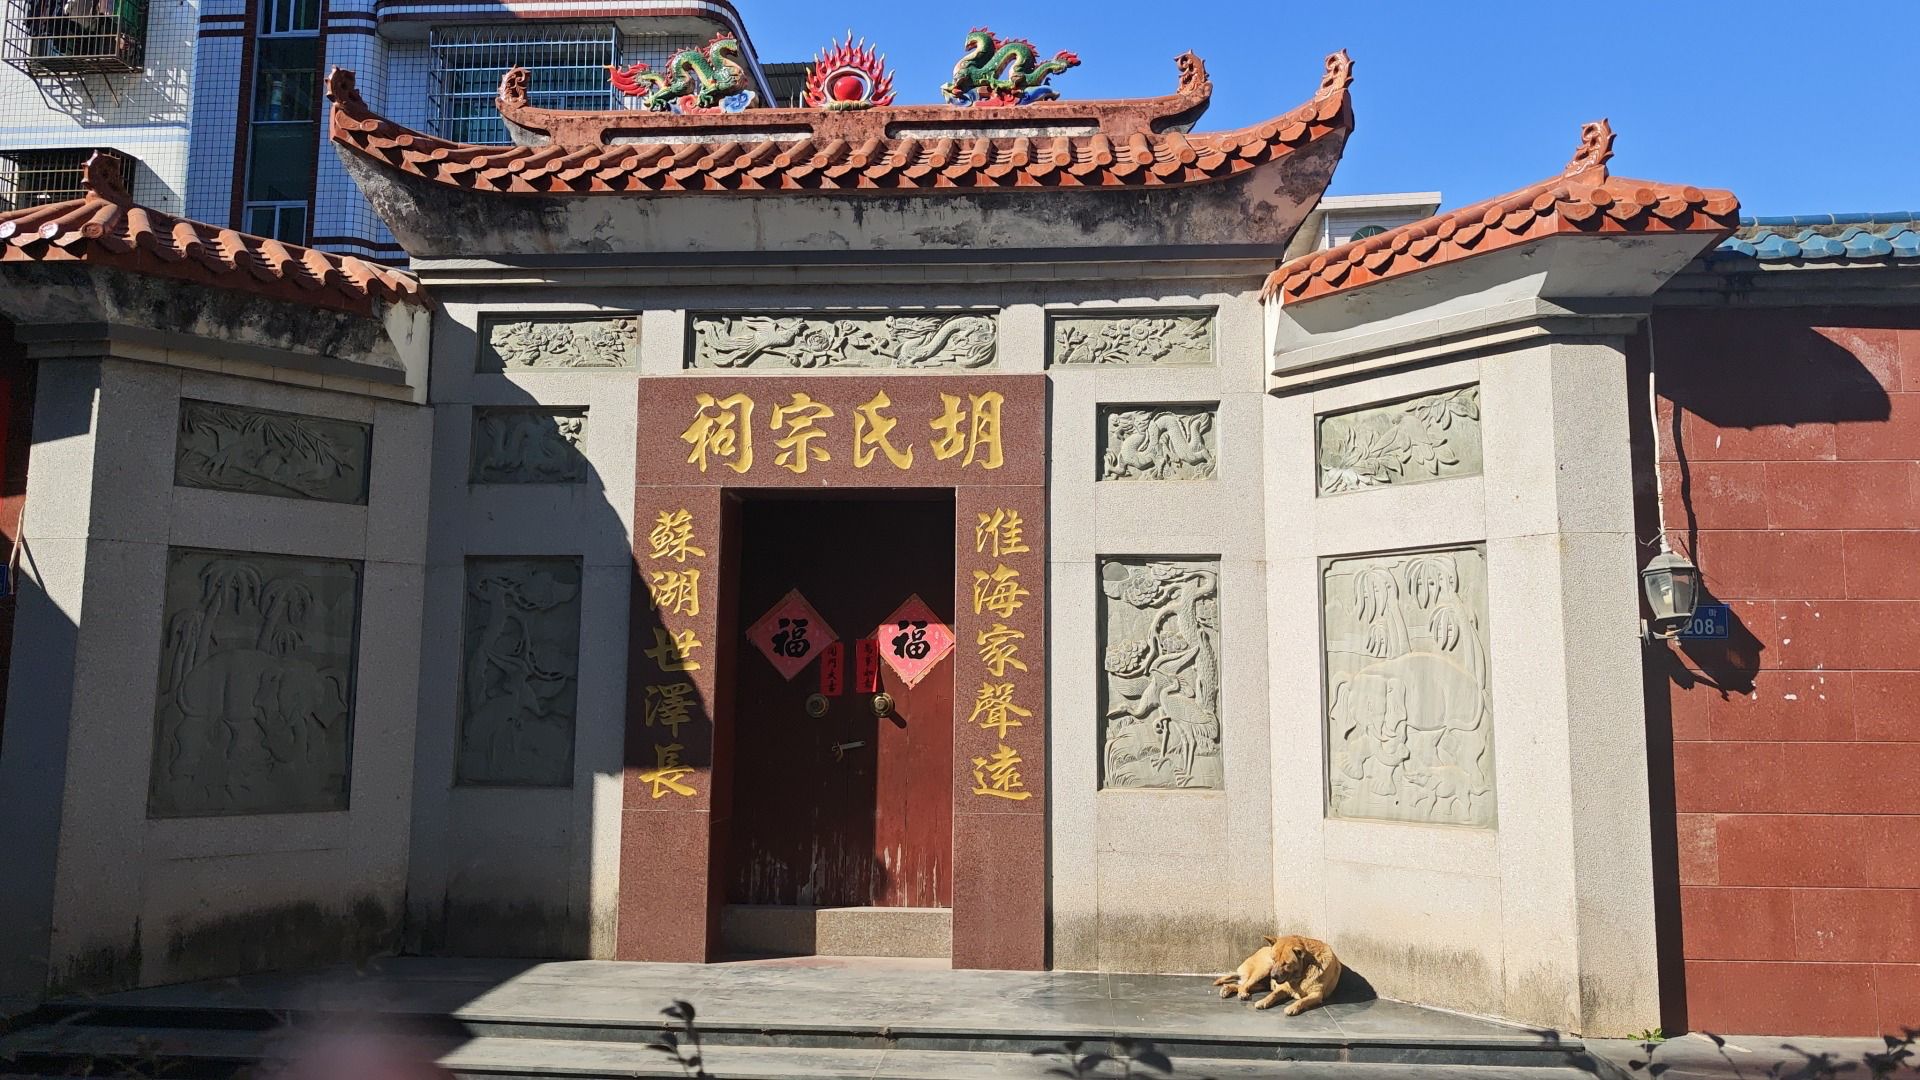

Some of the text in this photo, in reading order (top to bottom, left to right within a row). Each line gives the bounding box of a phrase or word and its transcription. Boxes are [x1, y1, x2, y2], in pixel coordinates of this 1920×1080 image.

[680, 389, 1005, 474] 胡氏宗祠
[639, 508, 706, 799] 蘇湖世澤長
[771, 618, 811, 658] 福
[891, 620, 931, 660] 福
[968, 506, 1033, 800] 淮海家聲遠
